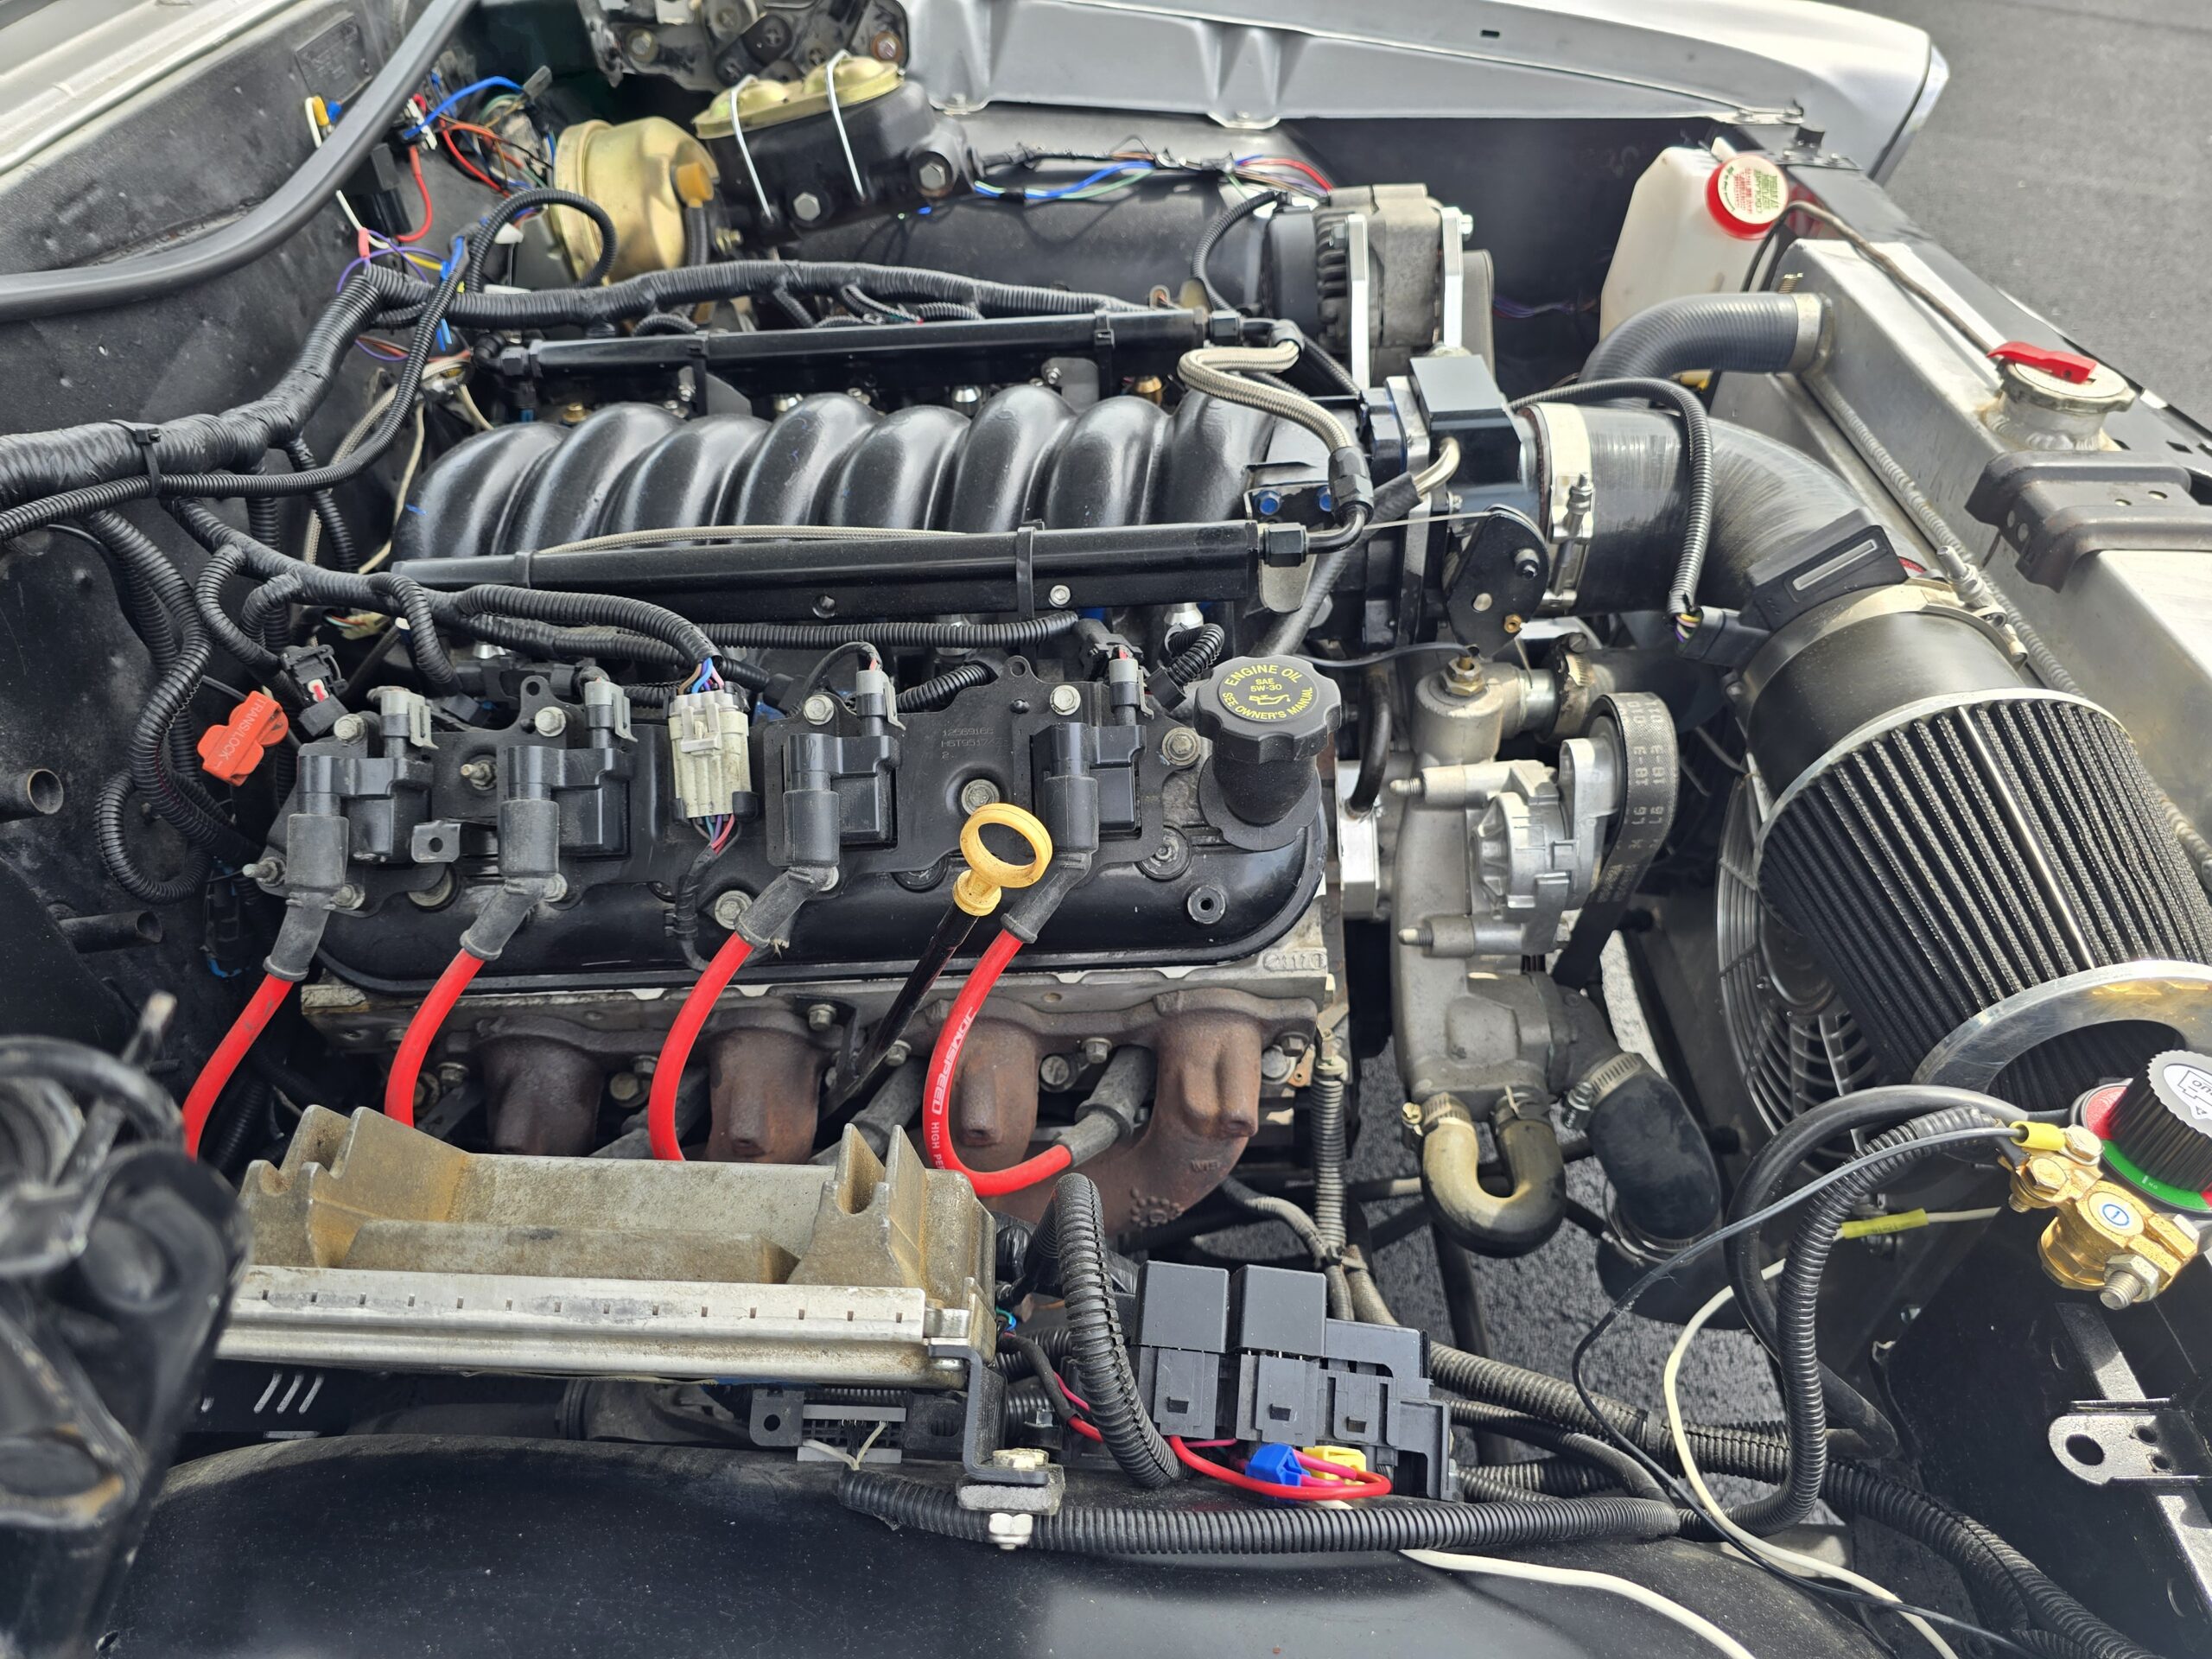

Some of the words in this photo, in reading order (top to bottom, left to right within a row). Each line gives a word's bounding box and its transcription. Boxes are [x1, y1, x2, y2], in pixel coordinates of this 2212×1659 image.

[1224, 664, 1279, 686] ENGINE
[1281, 668, 1303, 683] OIL
[1250, 683, 1282, 692] 5W-30
[1222, 692, 1239, 707] SEE
[1235, 705, 1287, 720] OWNER'S
[1287, 687, 1313, 715] MANUAL
[219, 698, 266, 761] TRANS/LOCK
[931, 1007, 977, 1116] JDMSPEED
[931, 1122, 940, 1149] HIGH
